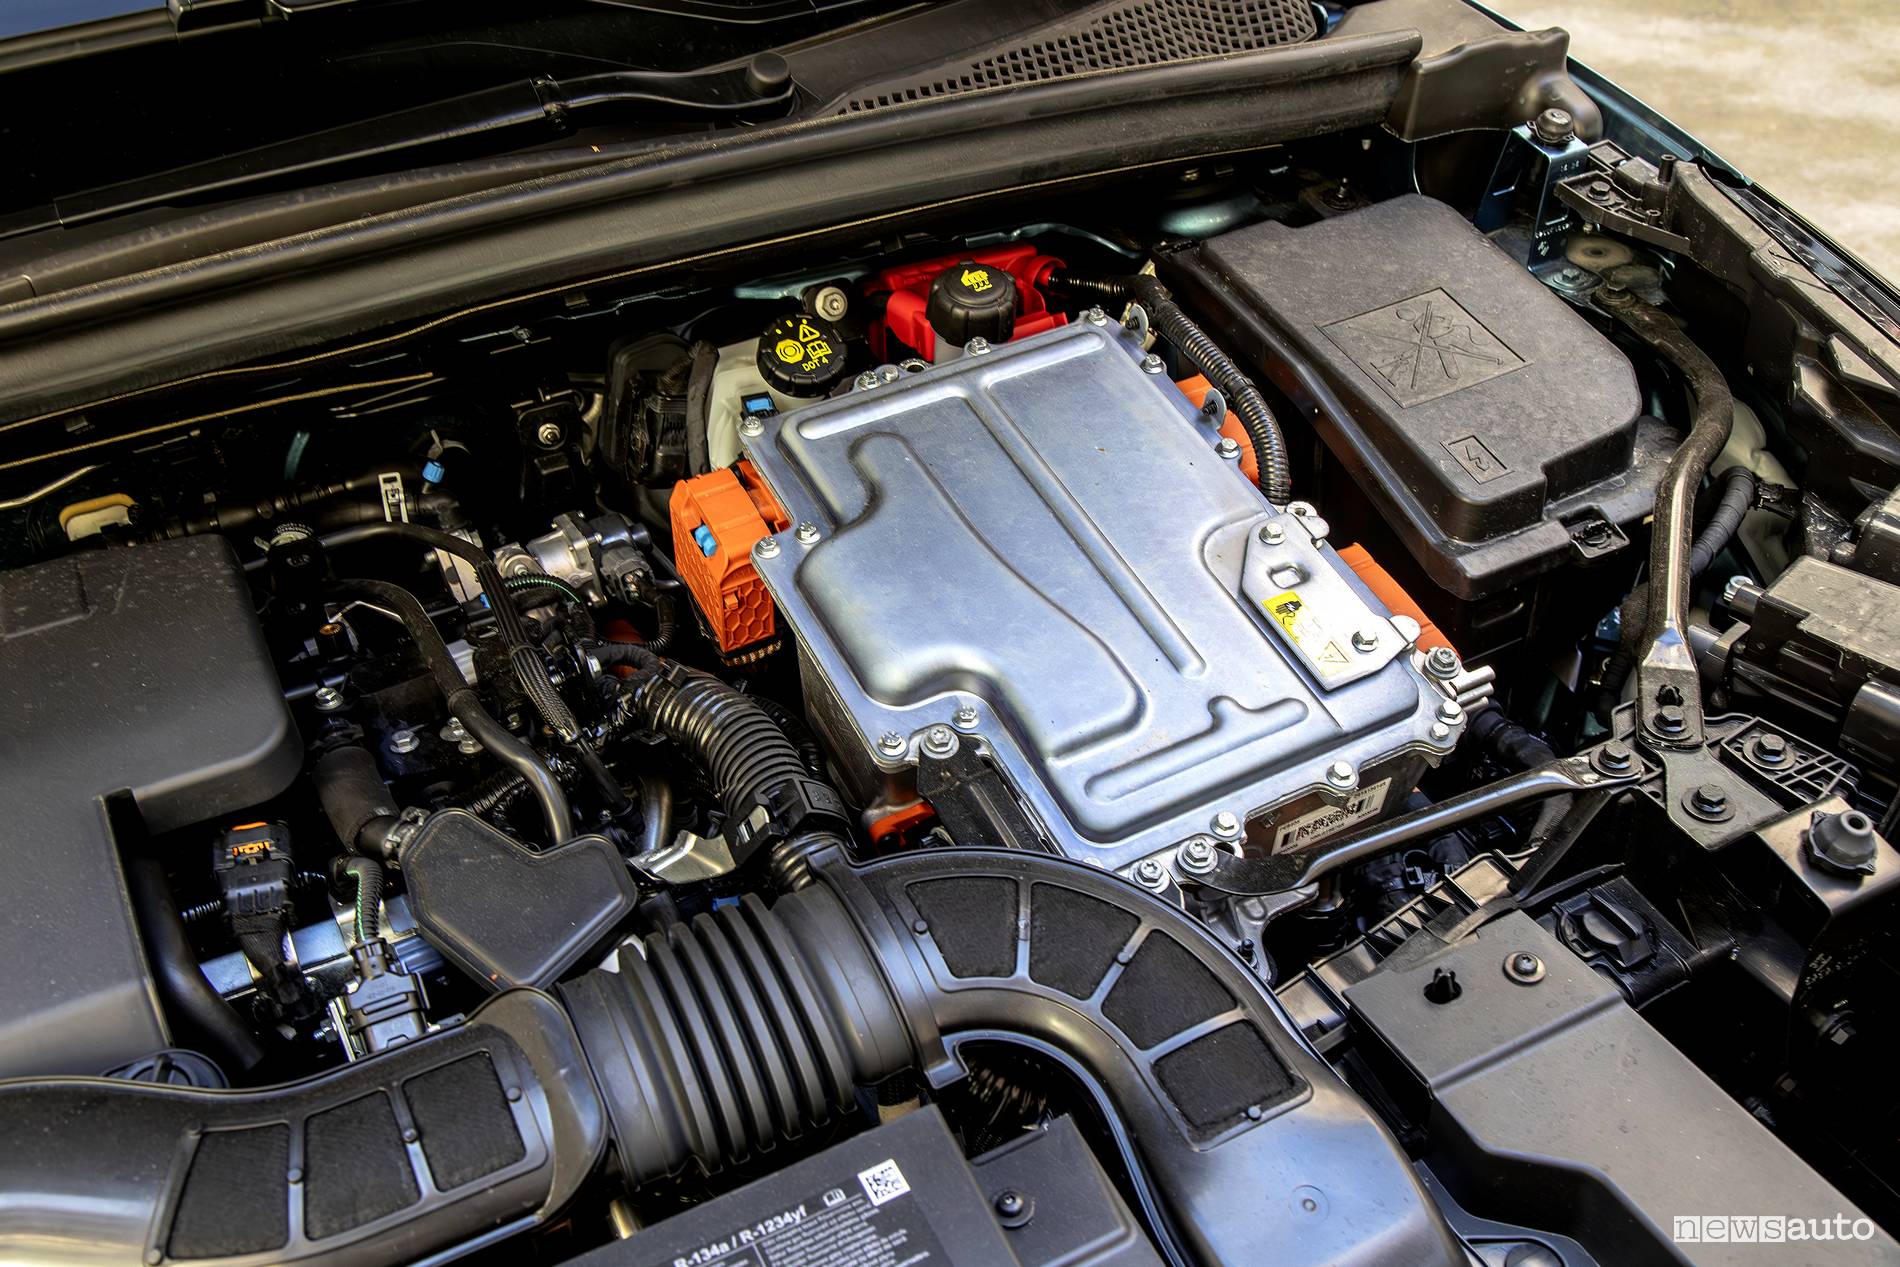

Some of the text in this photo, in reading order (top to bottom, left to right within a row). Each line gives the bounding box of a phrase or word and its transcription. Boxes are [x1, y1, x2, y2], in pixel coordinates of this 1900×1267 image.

[802, 356, 829, 372] DOT 4
[673, 1241, 731, 1267] R-134a
[738, 1204, 807, 1244] R-1234yf
